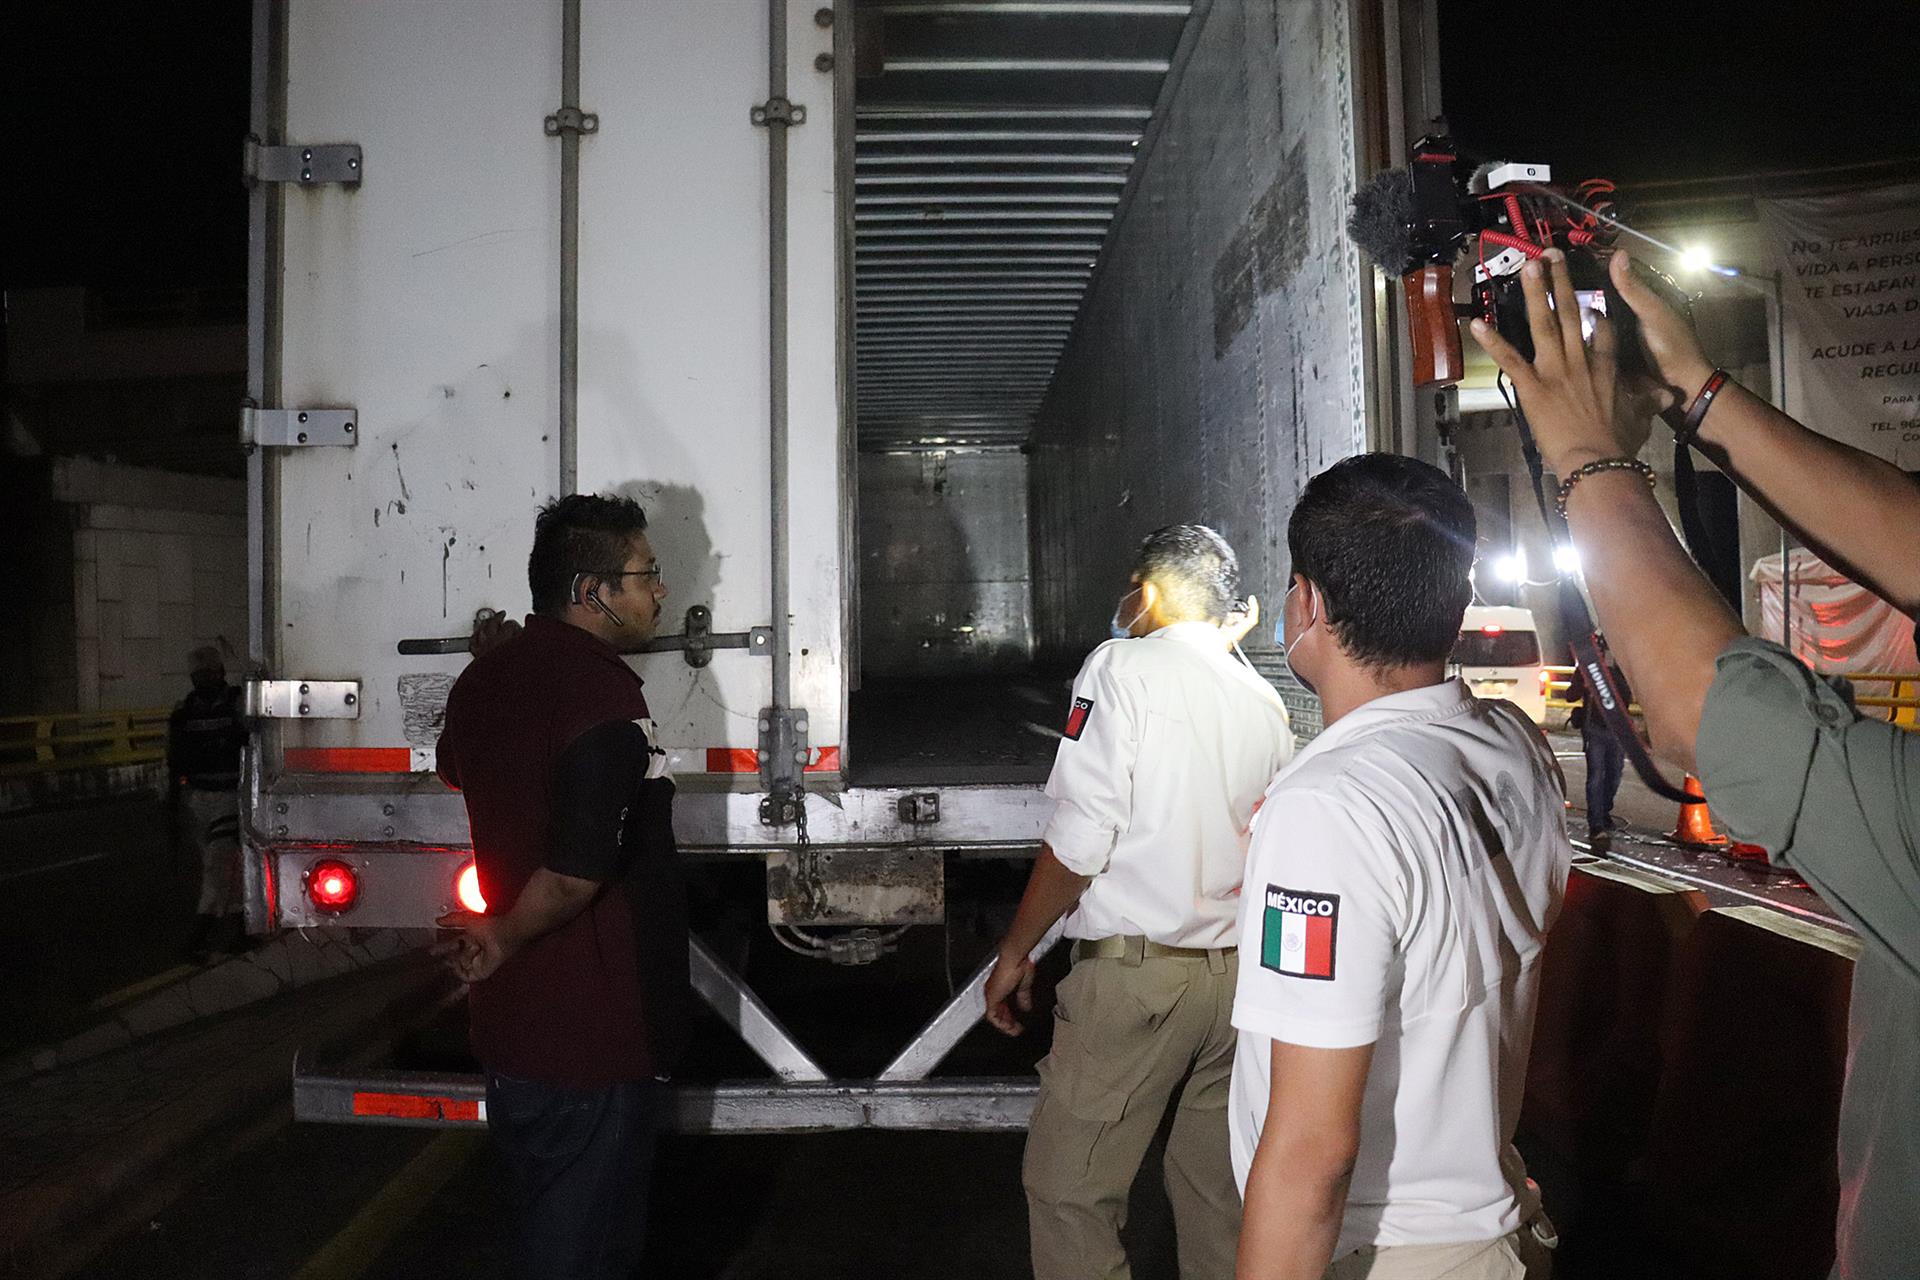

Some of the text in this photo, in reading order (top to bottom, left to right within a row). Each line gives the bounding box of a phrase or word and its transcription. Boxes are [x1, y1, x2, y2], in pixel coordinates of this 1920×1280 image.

[1792, 240, 1821, 255] NO
[1797, 262, 1840, 277] VIDA
[1846, 261, 1859, 273] A
[1804, 275, 1915, 299] TE ESTAFAN
[1843, 301, 1897, 319] VIAJA
[1812, 343, 1876, 360] ACUDE
[1881, 341, 1896, 354] A
[1882, 395, 1914, 405] PARA
[1266, 891, 1334, 916] MÉXICO
